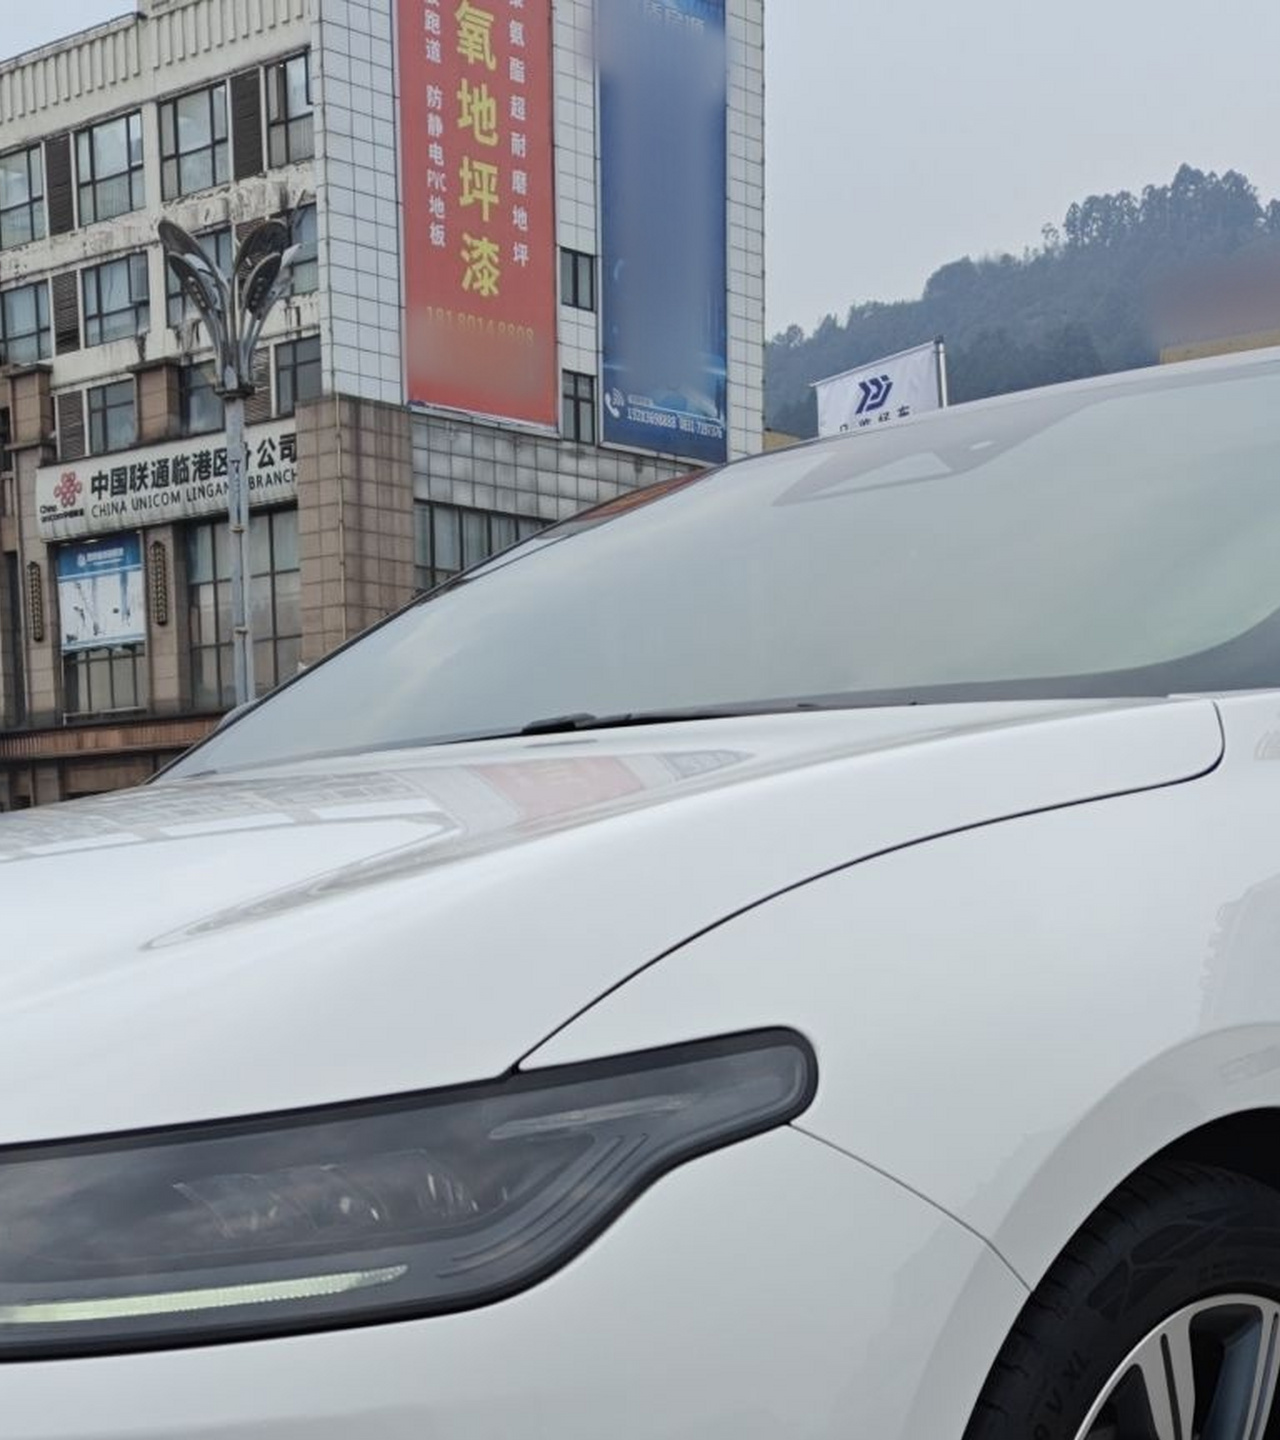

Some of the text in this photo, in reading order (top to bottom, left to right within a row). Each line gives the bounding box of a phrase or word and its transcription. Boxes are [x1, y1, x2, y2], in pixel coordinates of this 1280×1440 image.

[423, 0, 442, 64] 跑道
[455, 0, 500, 296] 氧地坪漆
[91, 500, 128, 518] CHINA
[131, 490, 181, 511] UNICOM
